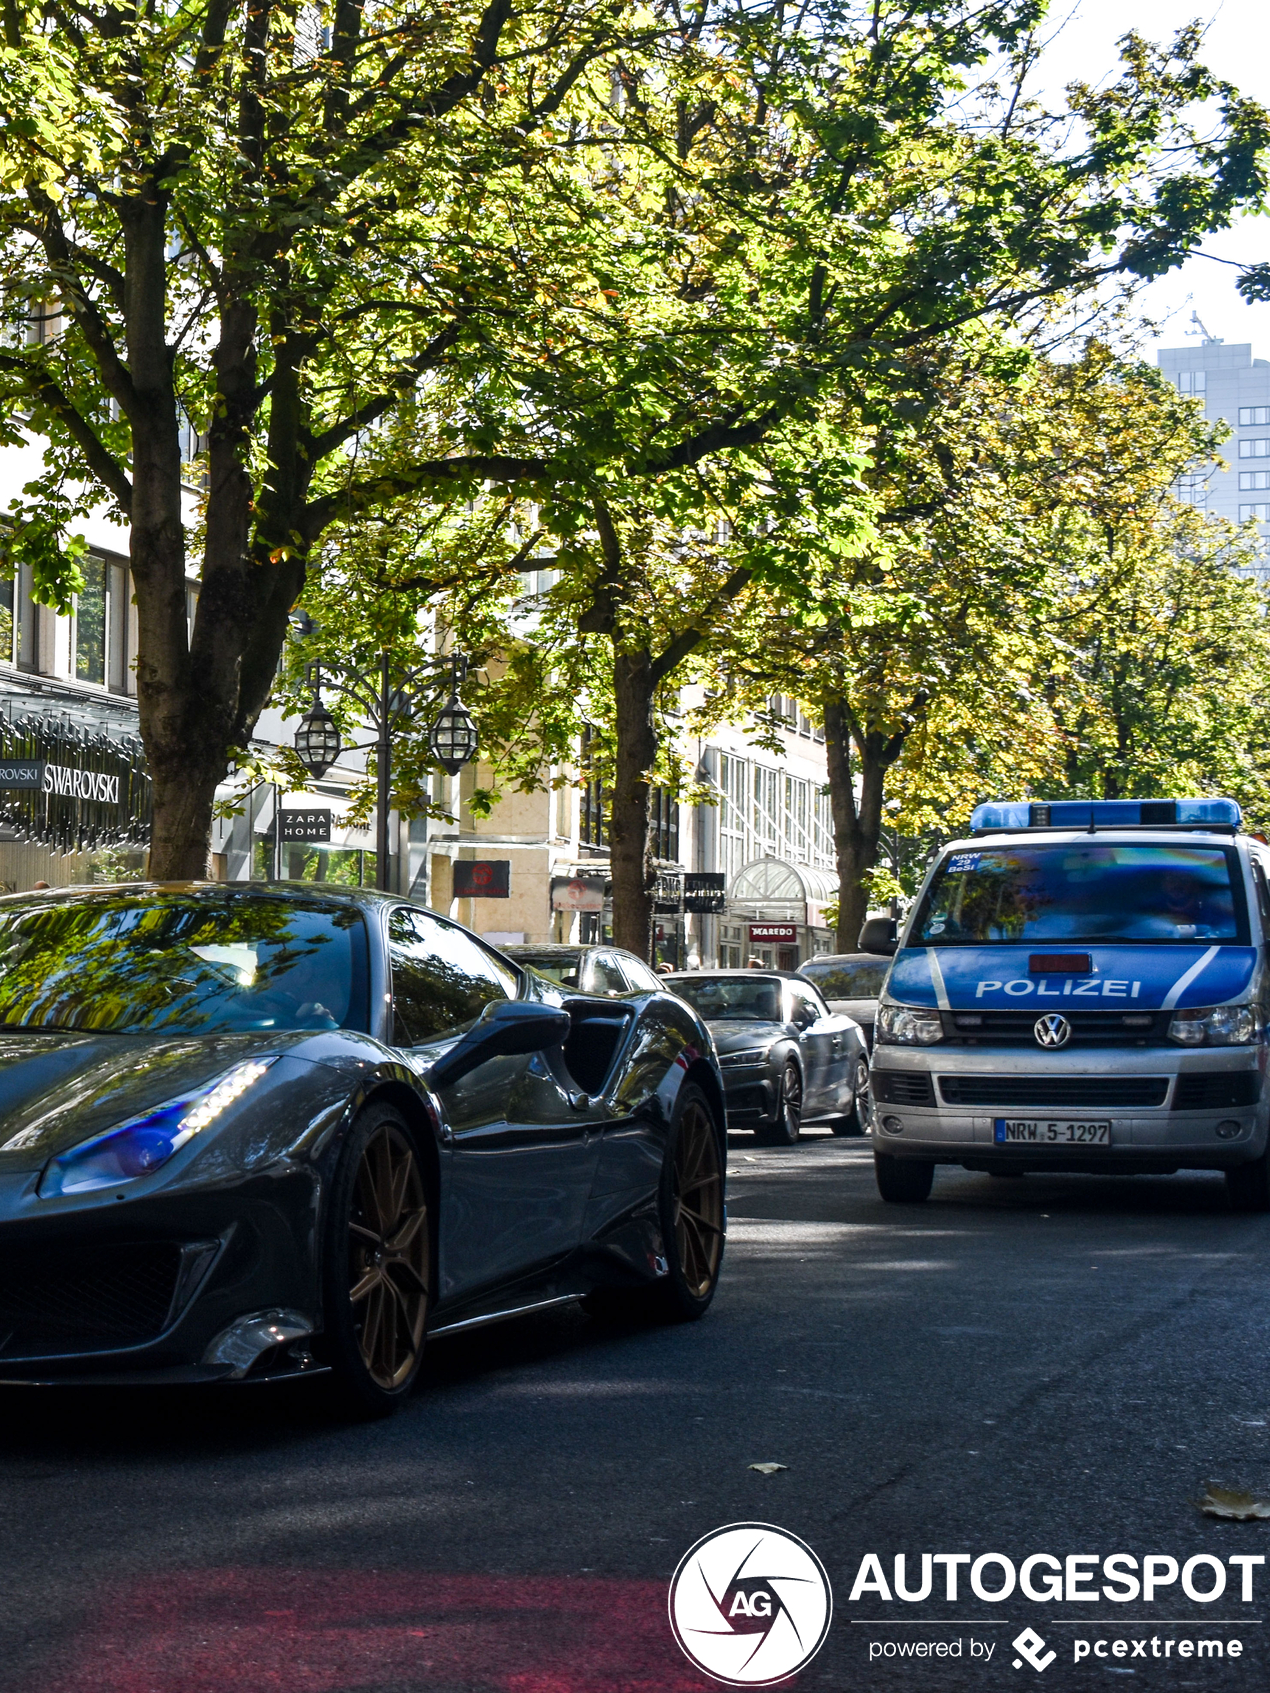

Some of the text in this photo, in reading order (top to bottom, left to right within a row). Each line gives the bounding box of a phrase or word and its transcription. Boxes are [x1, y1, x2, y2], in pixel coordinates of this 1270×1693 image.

[43, 763, 120, 804] SWAROVSKI
[286, 815, 326, 823] ZARA
[284, 827, 327, 836] HOME
[951, 852, 981, 861] NRW
[956, 859, 971, 867] 29
[751, 927, 793, 936] MAREDO
[975, 979, 1142, 998] POLIZEI
[1005, 1122, 1037, 1140] NRW
[1047, 1123, 1108, 1142] 5-1297
